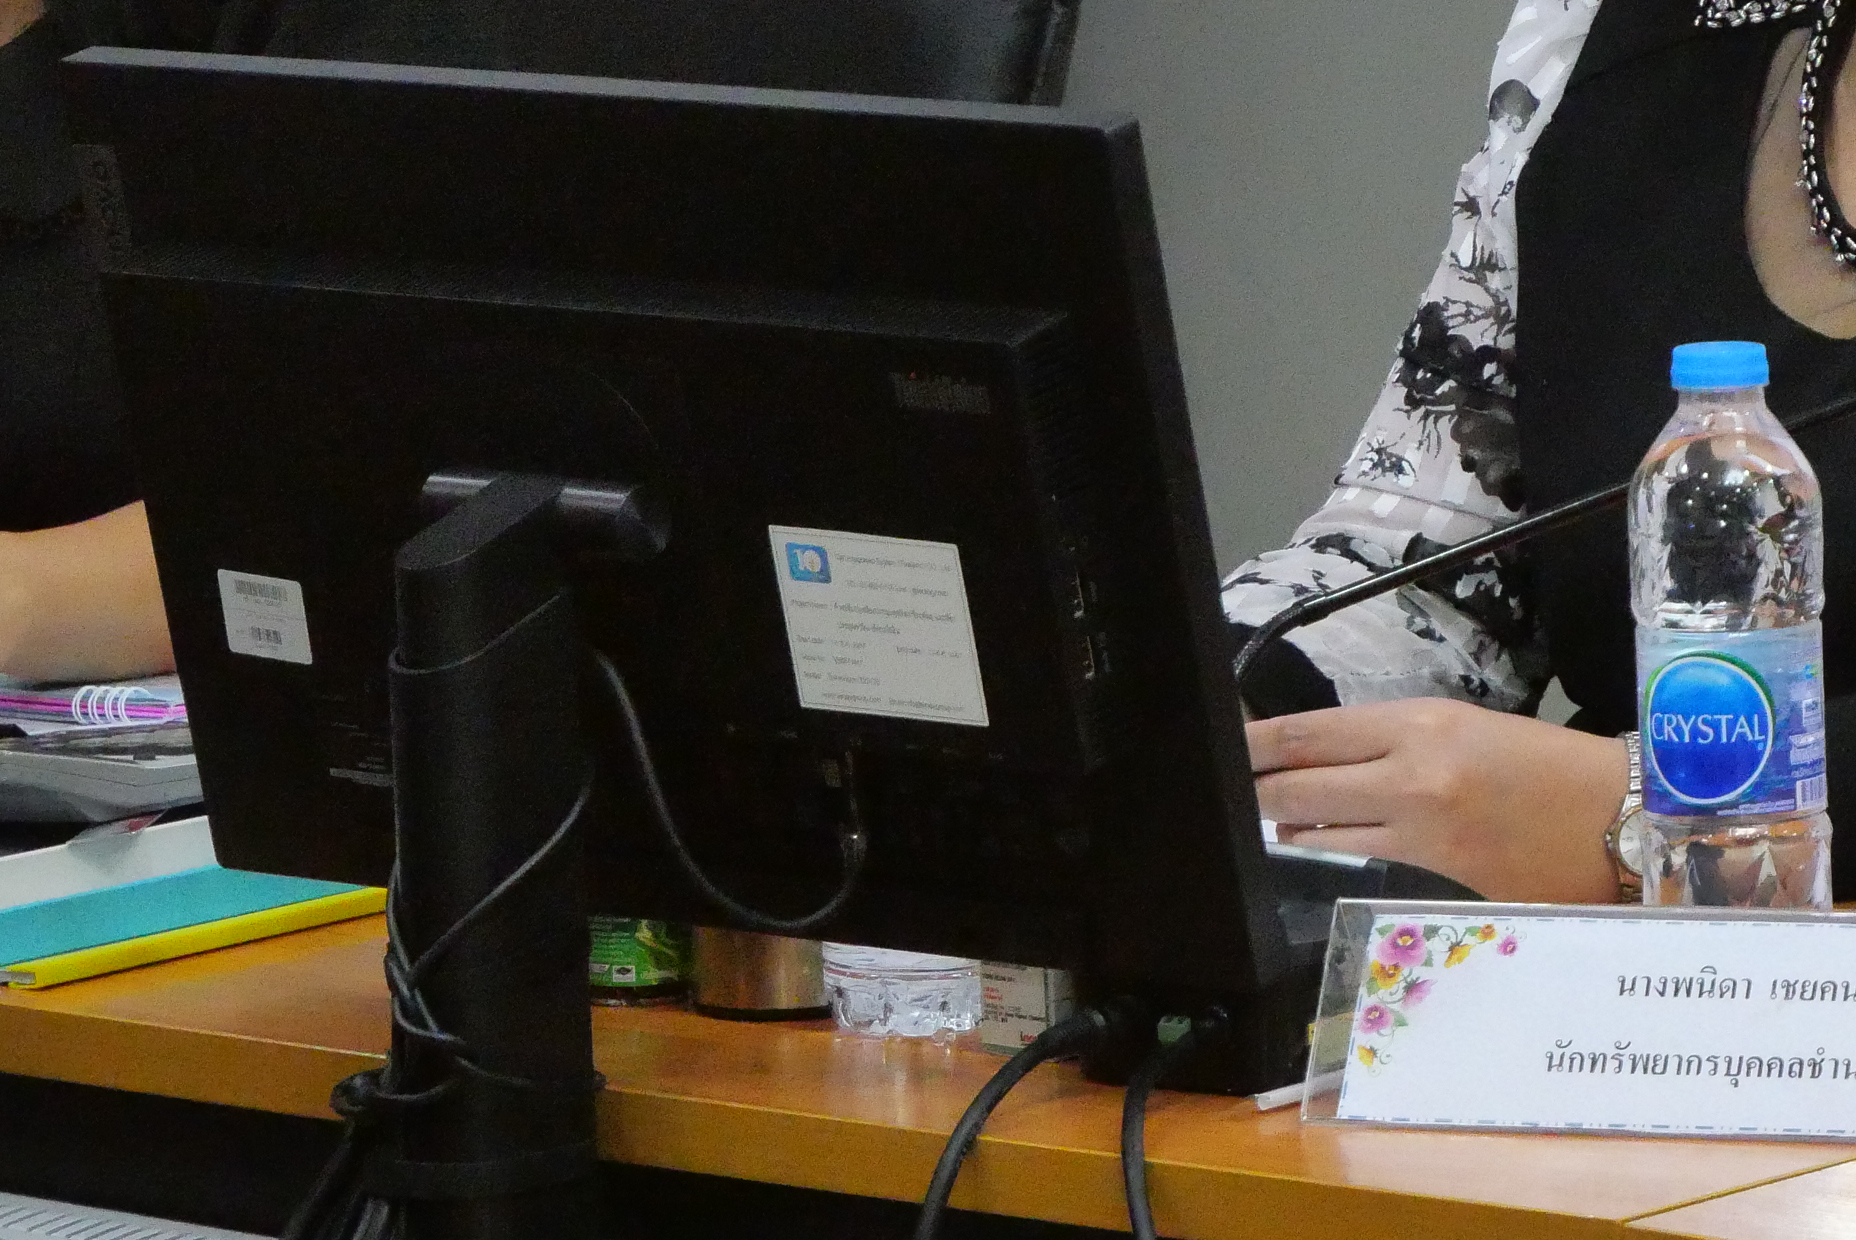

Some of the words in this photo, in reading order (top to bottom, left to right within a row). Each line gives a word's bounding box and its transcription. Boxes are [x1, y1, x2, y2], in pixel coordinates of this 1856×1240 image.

[1651, 711, 1766, 744] CRYSTAL
[1616, 964, 1753, 1000] นางพนิดา
